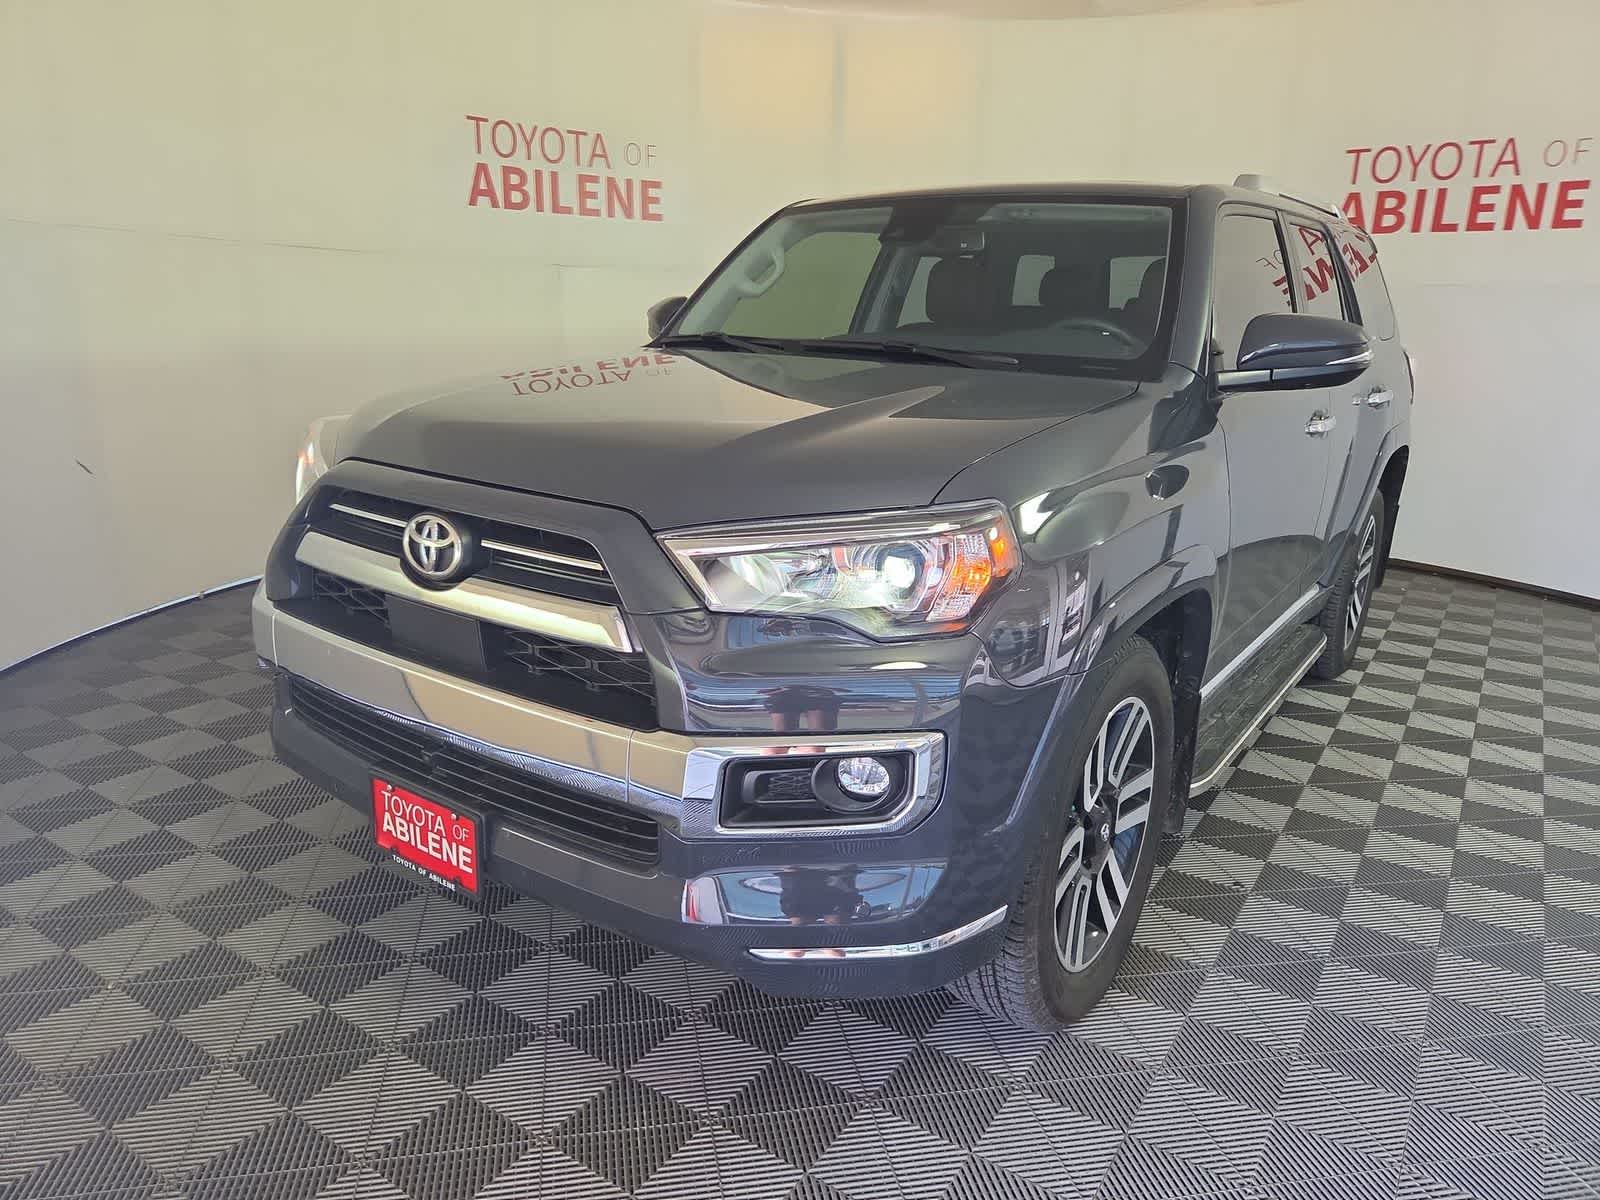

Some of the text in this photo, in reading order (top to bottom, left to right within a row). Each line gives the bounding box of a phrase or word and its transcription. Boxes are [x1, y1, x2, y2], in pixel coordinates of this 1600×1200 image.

[466, 115, 656, 169] TOYOTA OF
[1346, 137, 1593, 185] TOYOTA OF
[468, 162, 664, 222] ABILENE
[1341, 180, 1591, 235] ABILENE
[382, 790, 469, 841] TOYOTA OF
[383, 811, 473, 873] ABILENE
[392, 855, 456, 892] TOYOTA OF ABILENE
